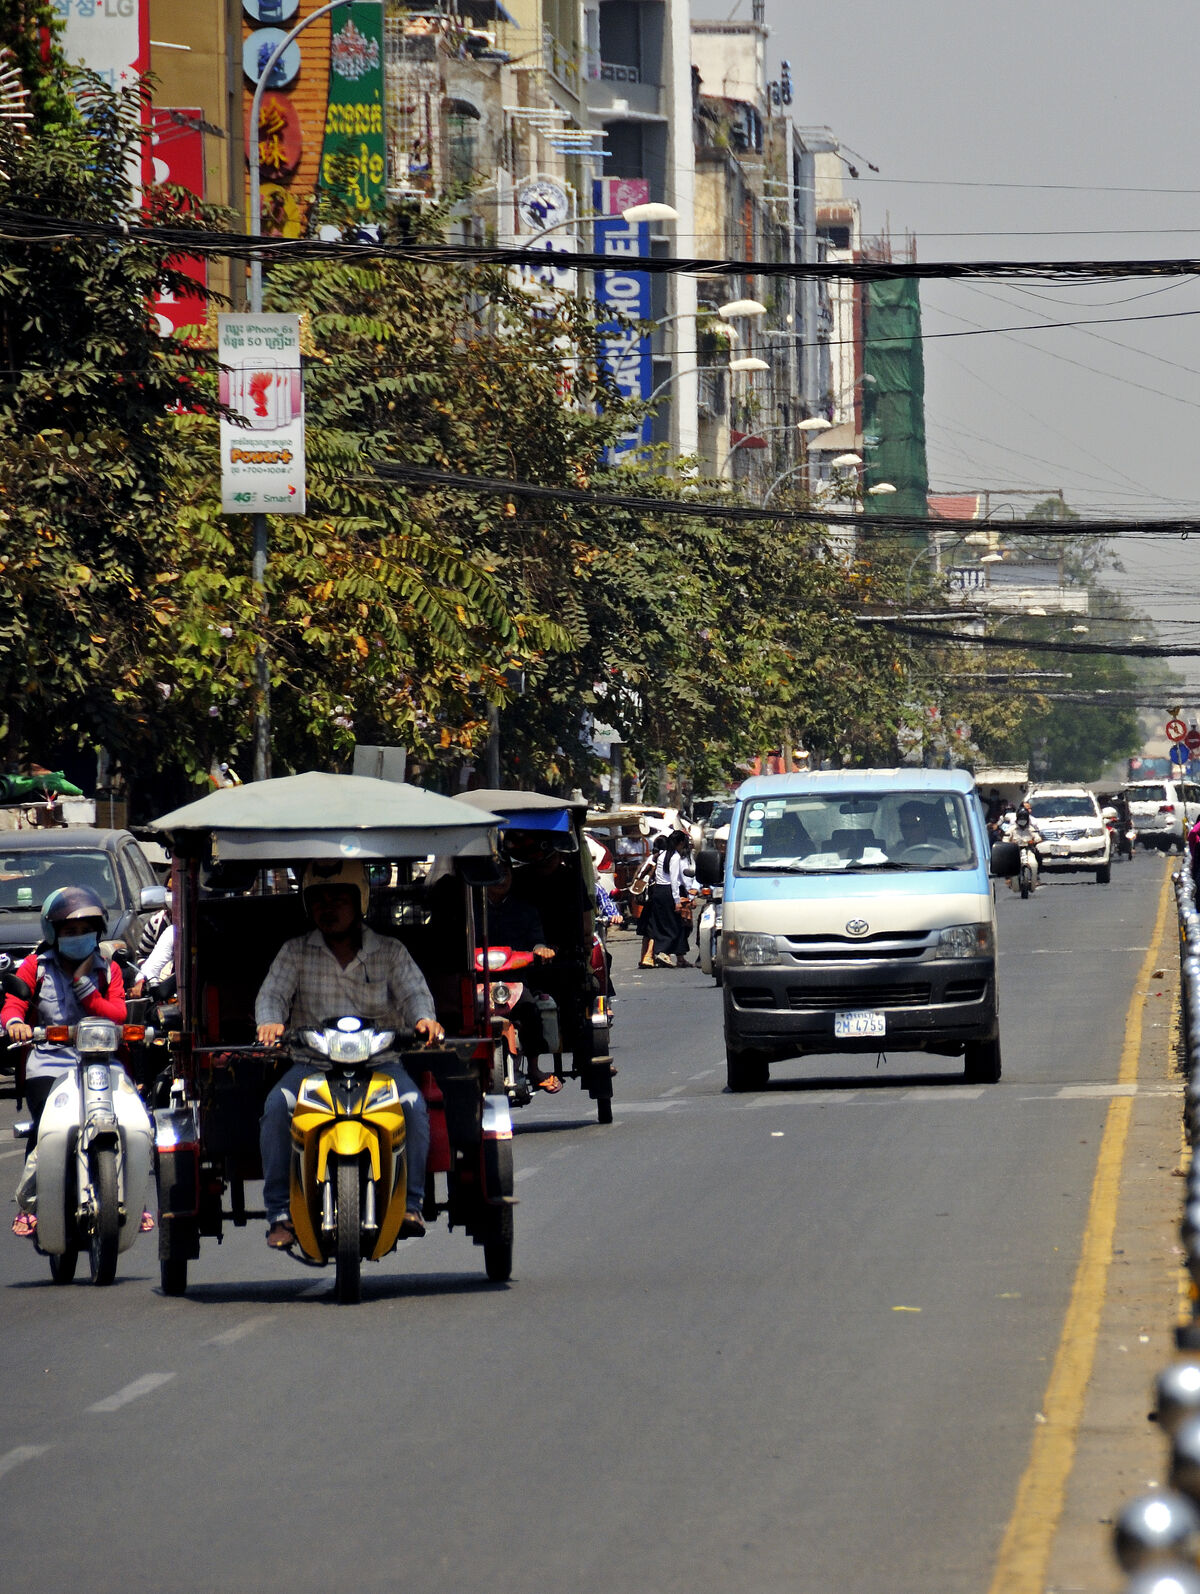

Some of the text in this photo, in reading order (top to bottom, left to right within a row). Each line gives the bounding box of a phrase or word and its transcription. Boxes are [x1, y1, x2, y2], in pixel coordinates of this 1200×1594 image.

[604, 219, 641, 319] HOEL
[247, 337, 262, 346] 50
[263, 494, 292, 503] Smart
